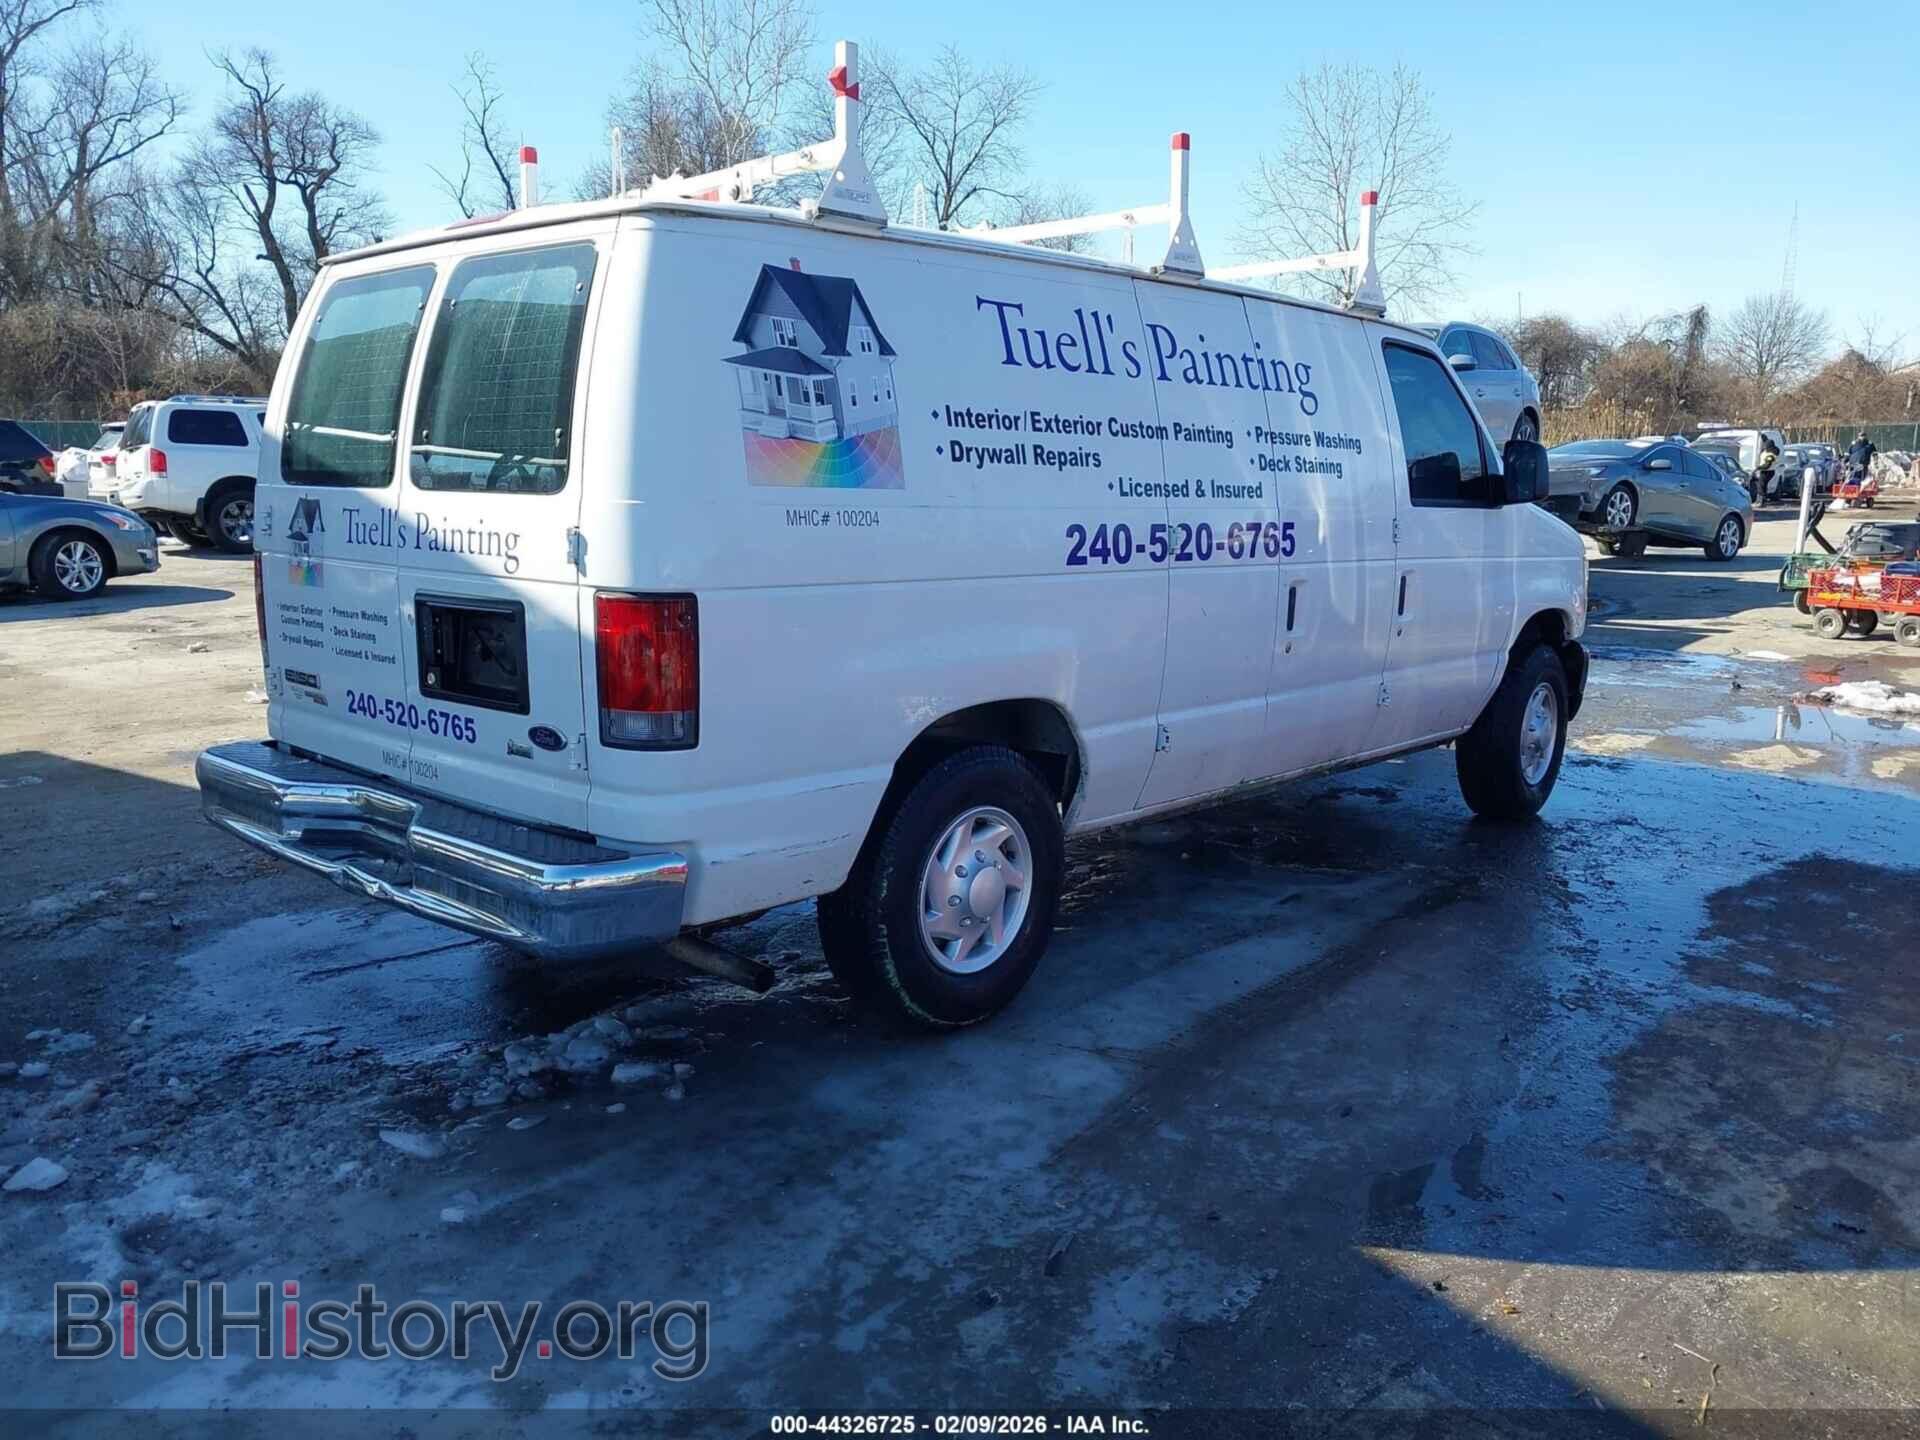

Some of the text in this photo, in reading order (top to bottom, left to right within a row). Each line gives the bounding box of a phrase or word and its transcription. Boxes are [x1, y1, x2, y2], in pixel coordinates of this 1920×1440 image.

[975, 295, 1318, 417] Tuell's Painting
[945, 404, 1234, 449] Interior/Exterior Custom Painting
[1255, 425, 1362, 454] Pressure Washing
[949, 439, 1102, 471] Drywall Repairs
[1258, 453, 1343, 479] Deck Staining
[1118, 476, 1264, 499] Licensed & Insured
[785, 509, 880, 527] MHIC# 100204
[342, 507, 520, 574] Tuell's Painting
[1065, 521, 1296, 566] 240-520-6765
[332, 606, 388, 626] Pressure Washing
[334, 626, 377, 644] Deck Staining
[335, 647, 363, 659] Licensed
[371, 652, 396, 665] Insured
[346, 690, 477, 744] 240-520-6765
